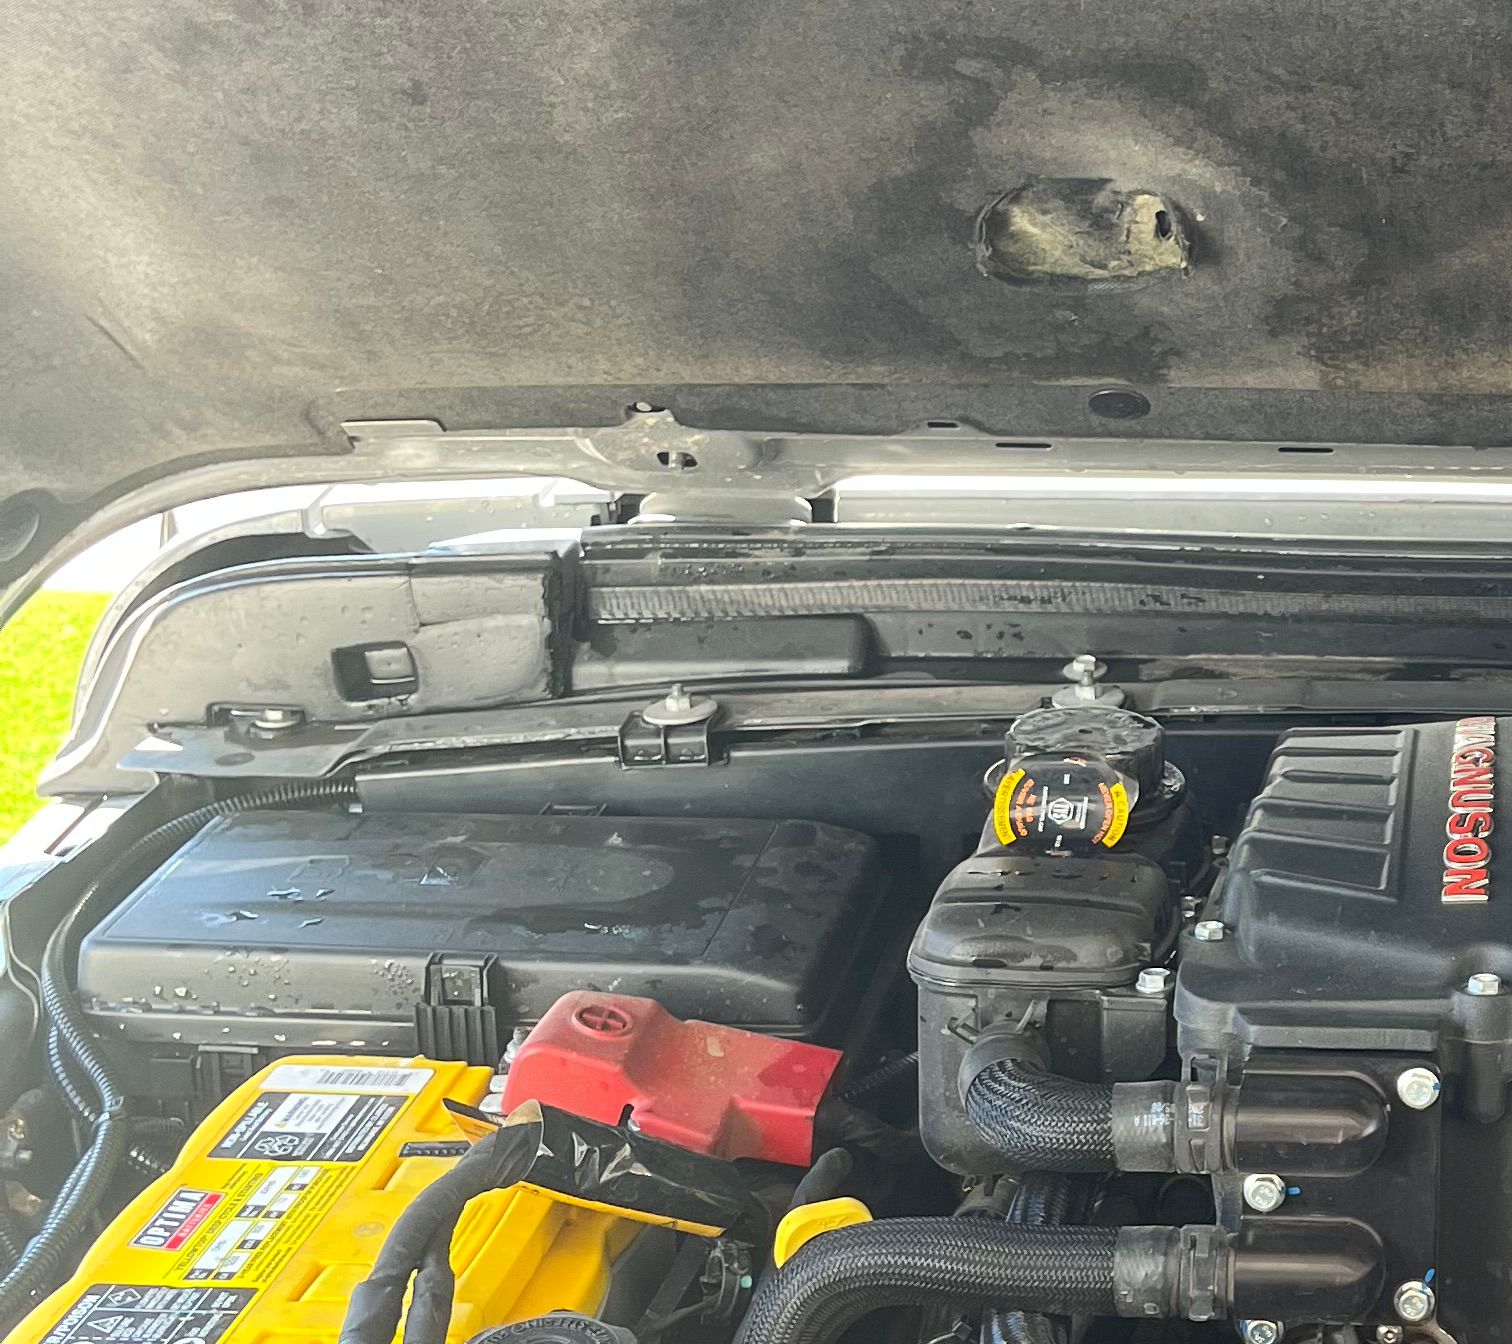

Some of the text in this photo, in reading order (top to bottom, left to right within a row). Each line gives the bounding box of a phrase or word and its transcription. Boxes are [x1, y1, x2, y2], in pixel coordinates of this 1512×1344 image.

[997, 773, 1015, 841] AVERTISSEMENT
[1107, 800, 1125, 842] CAUTION
[1441, 716, 1496, 904] MAGNUSON
[139, 1191, 206, 1246] OPTIMA
